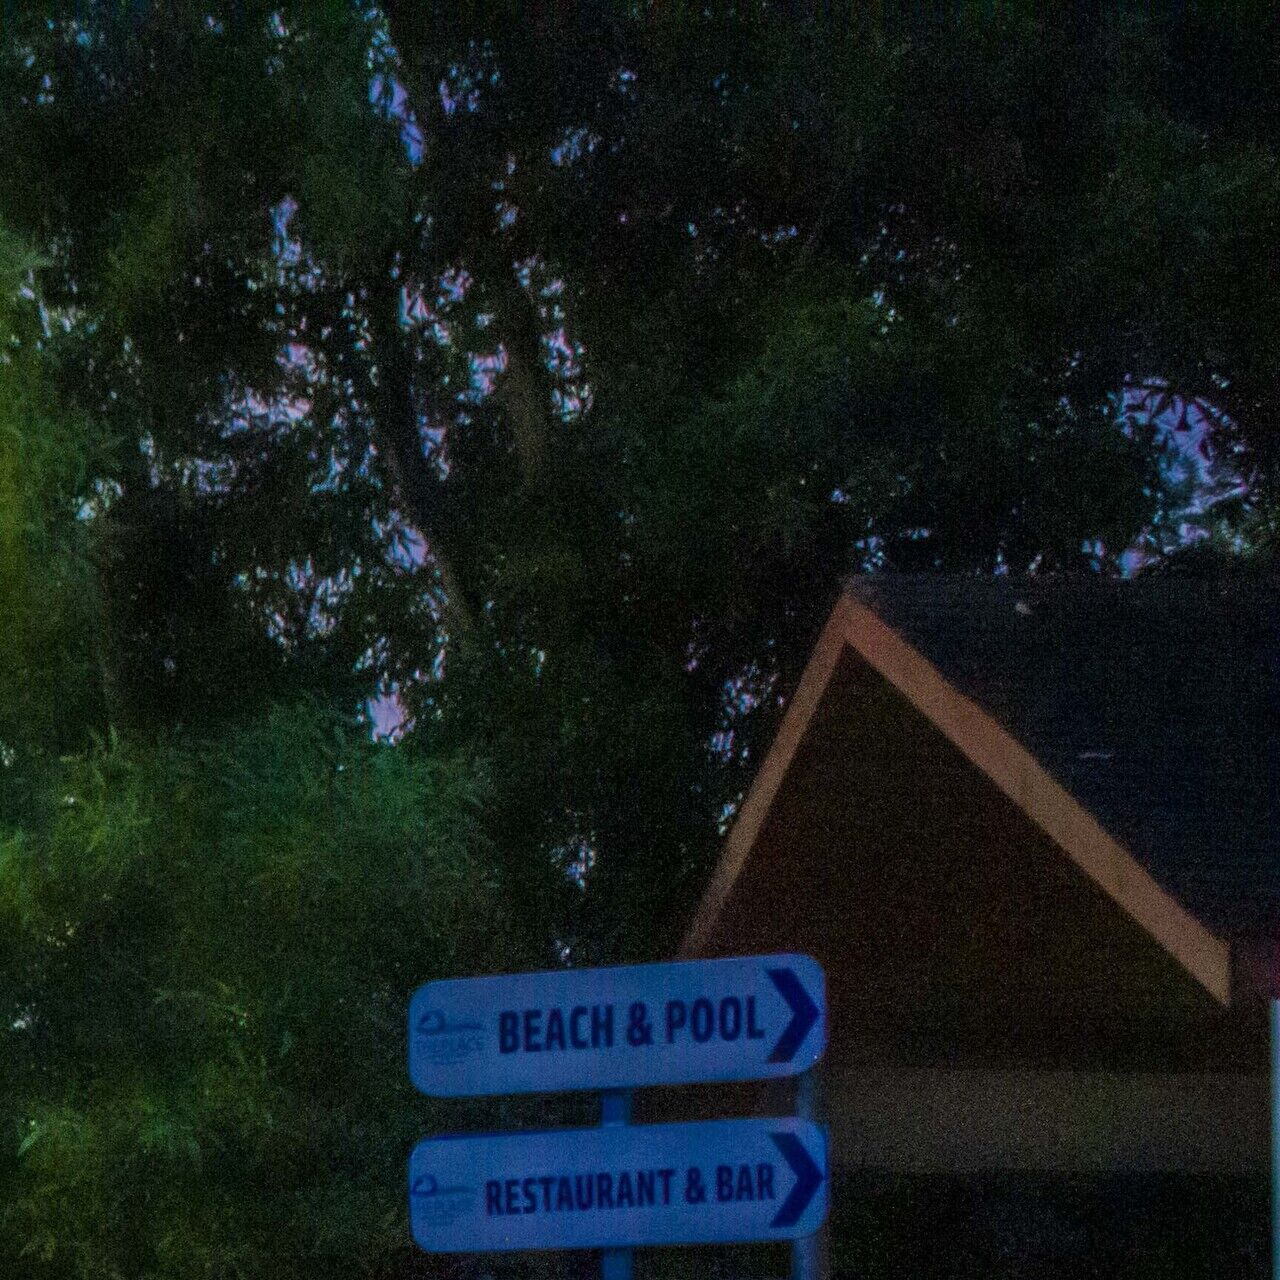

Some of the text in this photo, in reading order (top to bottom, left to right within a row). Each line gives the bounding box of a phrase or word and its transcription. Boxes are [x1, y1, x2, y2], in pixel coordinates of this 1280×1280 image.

[498, 1003, 615, 1055] BEACH
[627, 1001, 653, 1046] &
[666, 995, 765, 1042] POOL
[485, 1169, 674, 1215] RESTAURANT
[685, 1169, 706, 1204] &
[717, 1164, 775, 1202] BAR
